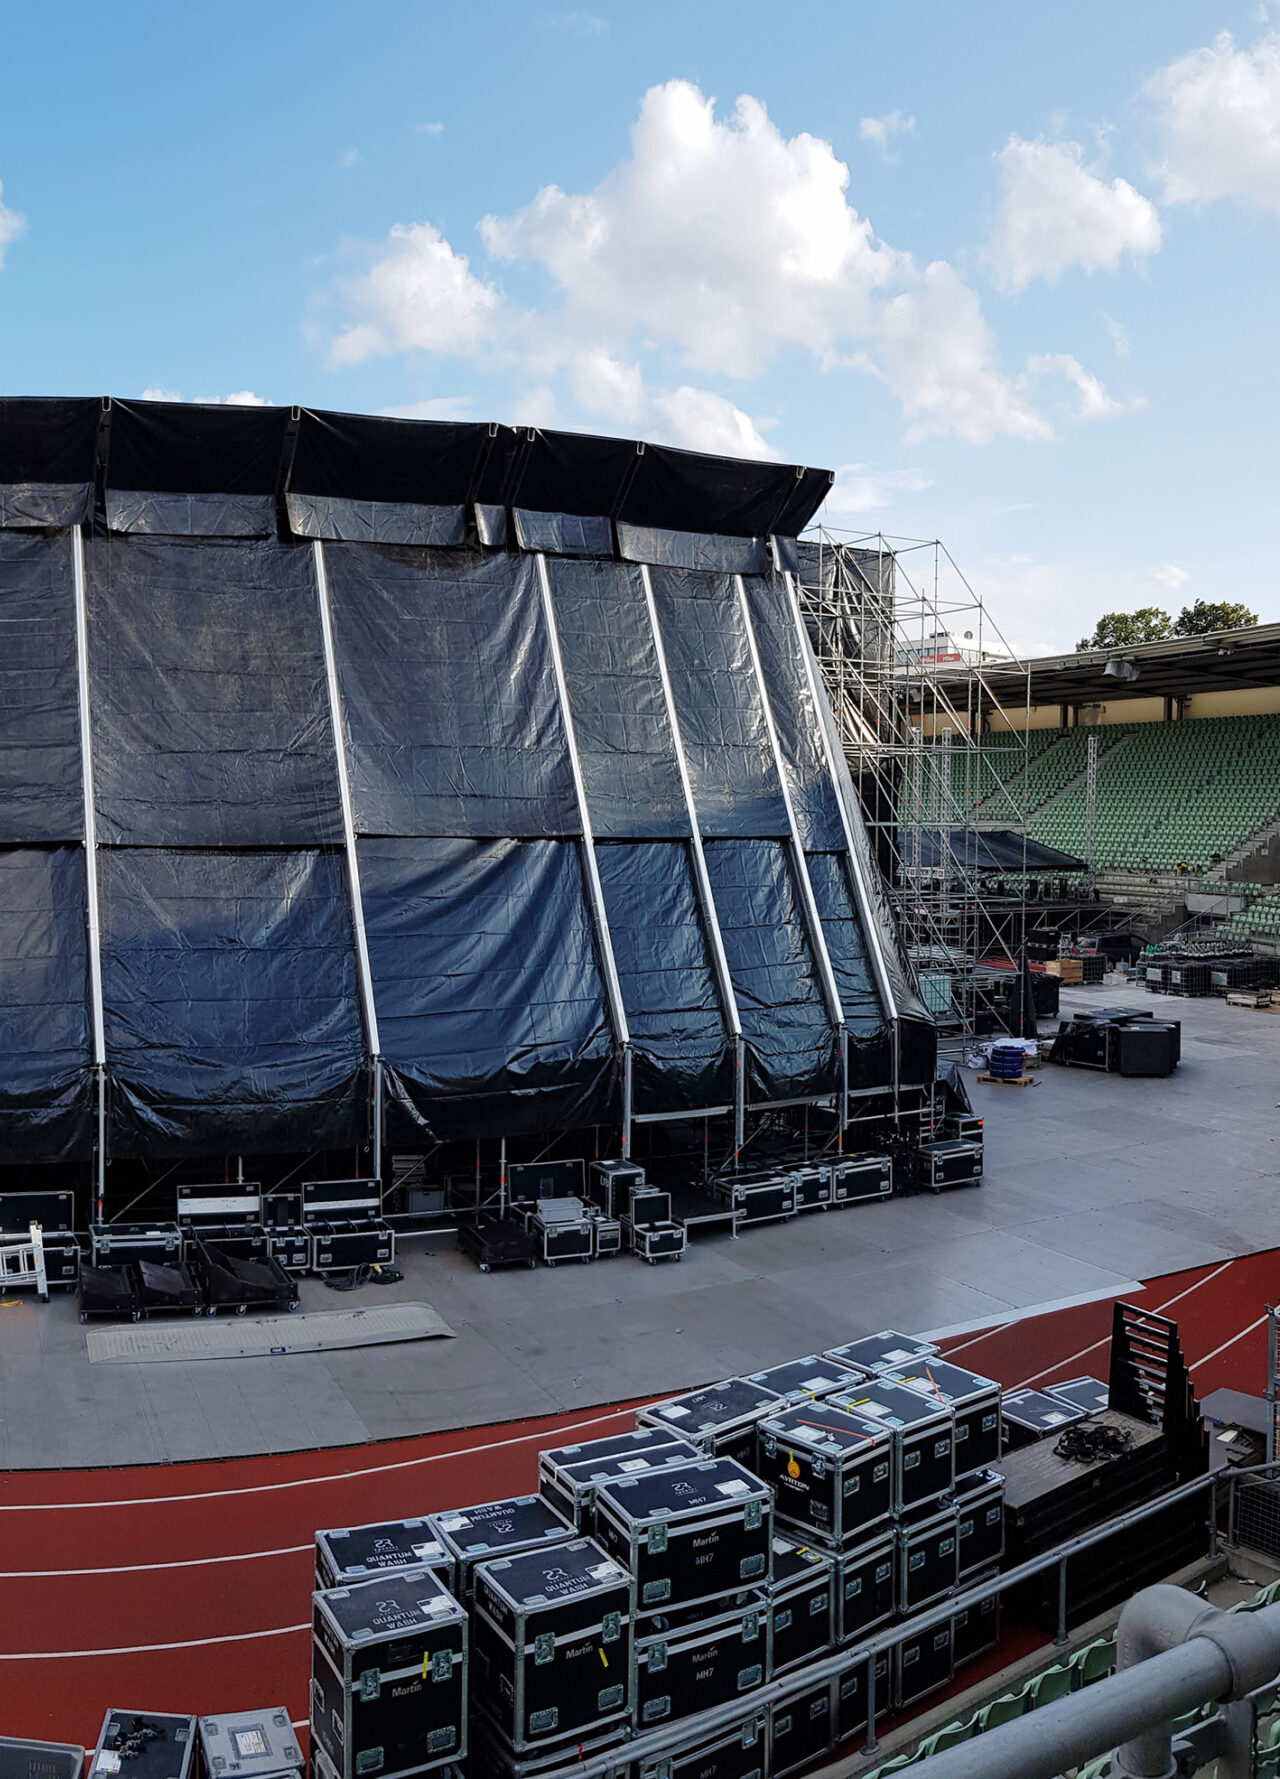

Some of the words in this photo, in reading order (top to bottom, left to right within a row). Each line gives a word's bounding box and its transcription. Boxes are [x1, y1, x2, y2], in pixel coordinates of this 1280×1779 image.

[692, 1532, 720, 1548] Martin
[366, 1551, 413, 1563] QUANTUM
[378, 1559, 408, 1568] WASH
[695, 1553, 715, 1566] MH7
[545, 1574, 593, 1592] QUANTUM
[559, 1583, 589, 1595] WASH
[372, 1608, 421, 1625] QUANTUM
[385, 1618, 418, 1630] WASH
[565, 1642, 594, 1660] Martin
[692, 1647, 718, 1663] Martin
[696, 1667, 714, 1681] MH7
[392, 1682, 423, 1698] Martin
